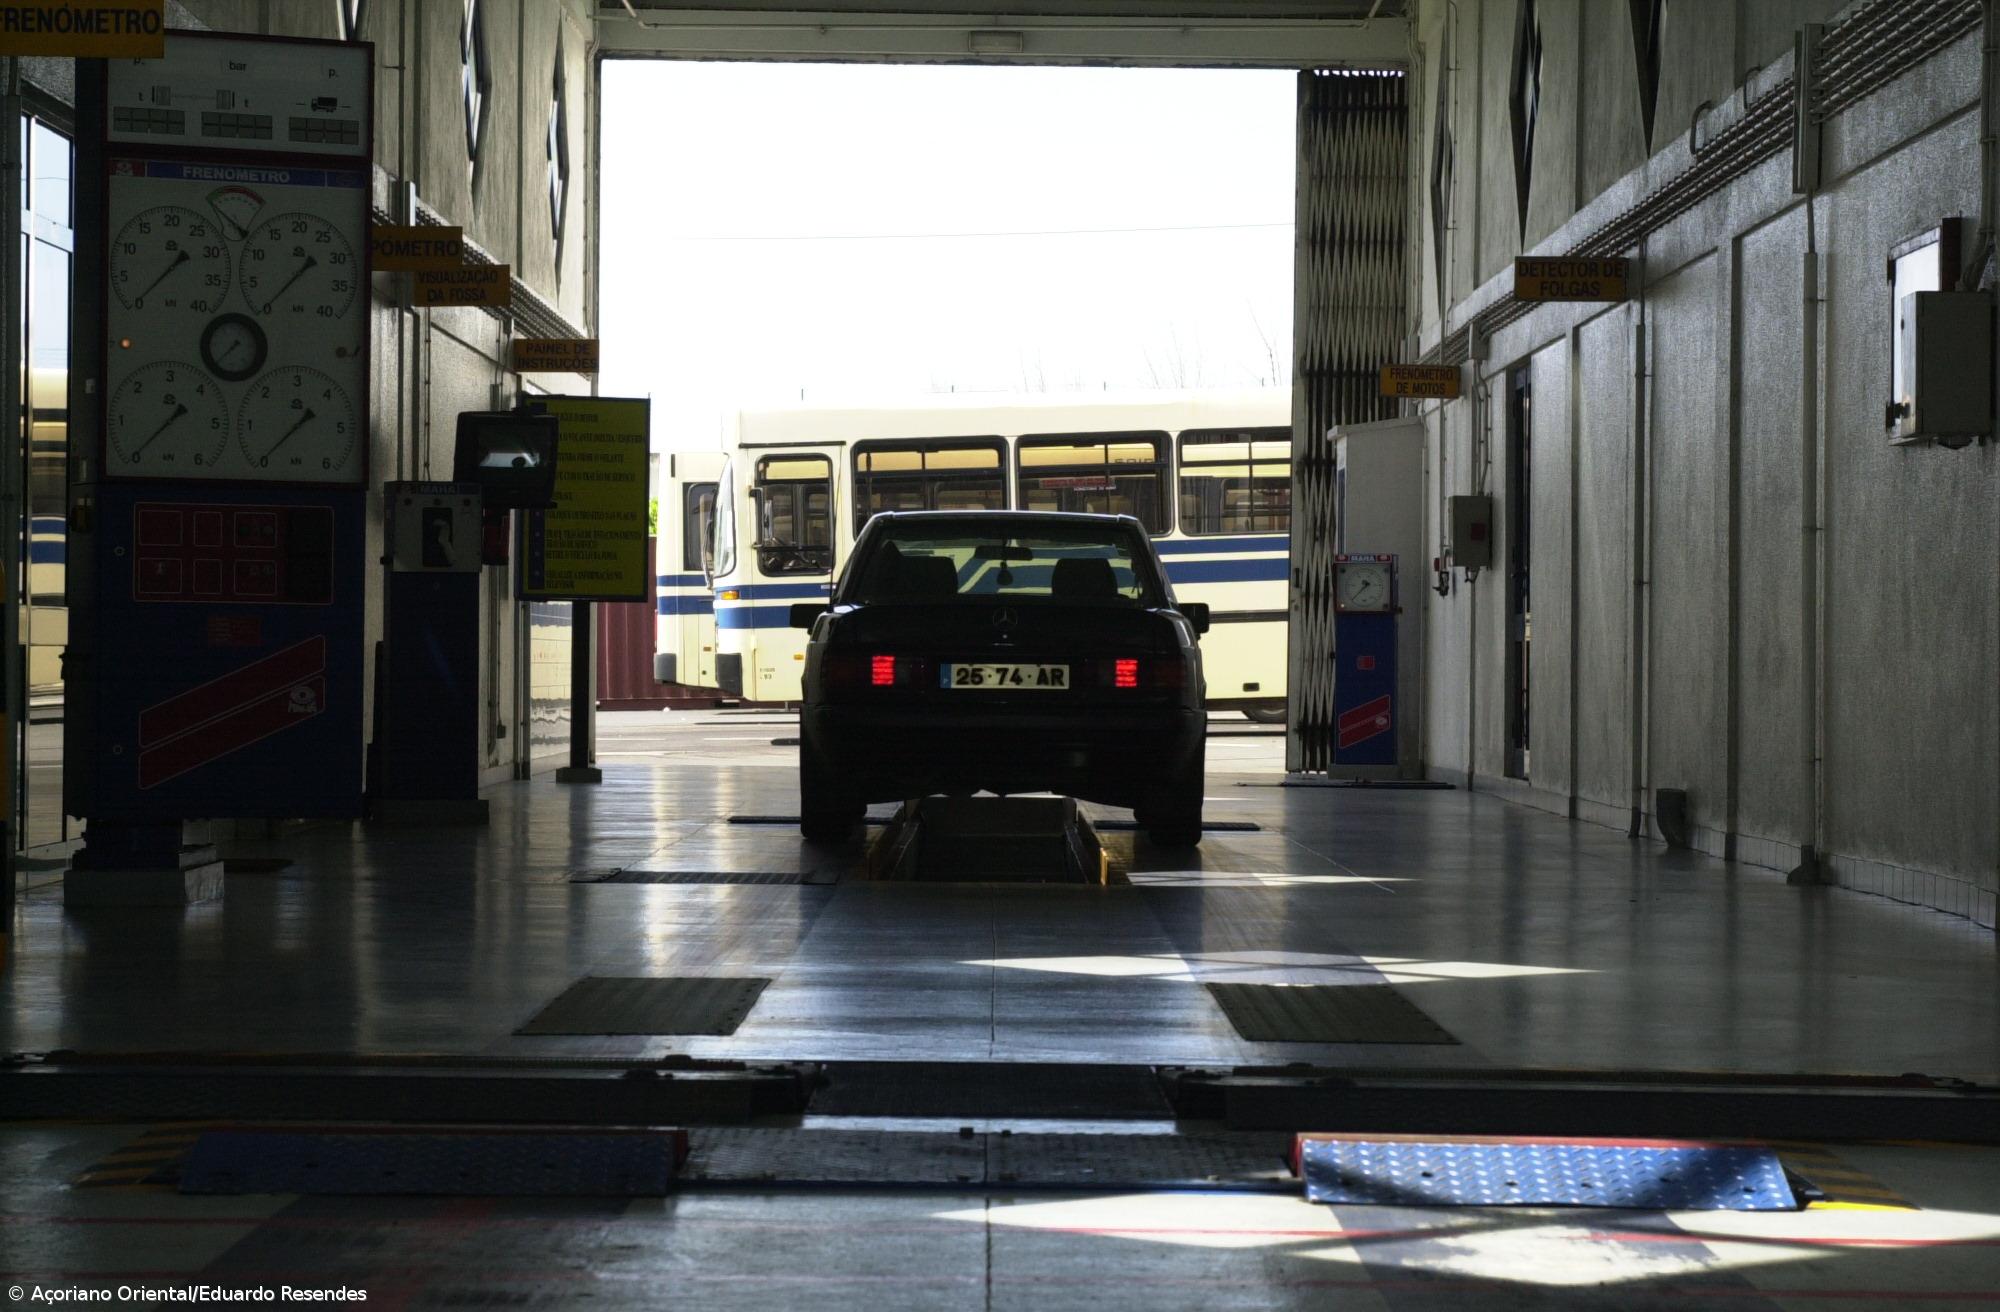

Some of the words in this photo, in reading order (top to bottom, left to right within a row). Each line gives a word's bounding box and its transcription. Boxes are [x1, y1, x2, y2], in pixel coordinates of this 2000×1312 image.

[0, 2, 160, 34] RENÓMETRO
[229, 61, 246, 71] bar
[182, 165, 290, 183] FRENOMETRO
[164, 215, 180, 227] 20
[139, 223, 151, 234] 15
[189, 225, 205, 237] 25
[292, 222, 307, 233] 20
[269, 229, 281, 241] 15
[315, 231, 332, 244] 25
[124, 243, 136, 255] 10
[203, 247, 220, 258] 30
[252, 249, 265, 261] 10
[330, 252, 346, 264] 30
[1518, 261, 1598, 277] DETECTOR
[1603, 261, 1624, 277] DE
[120, 270, 128, 282] 5
[205, 275, 221, 286] 35
[250, 277, 258, 288] 5
[332, 280, 348, 292] 35
[427, 288, 443, 302] DA
[449, 288, 487, 301] FOSSA
[1540, 281, 1600, 297] FOLGAS
[135, 298, 144, 309] 0
[190, 301, 207, 313] 40
[263, 303, 271, 314] 0
[317, 305, 334, 317] 40
[574, 342, 590, 354] DE
[166, 370, 174, 382] 3
[293, 375, 301, 387] 3
[134, 381, 143, 394] 2
[196, 384, 204, 395] 4
[262, 387, 270, 398] 2
[1396, 381, 1409, 394] DE
[1412, 382, 1446, 395] MOTOS
[323, 389, 332, 400] 4
[211, 418, 220, 430] 5
[337, 423, 345, 434] 5
[131, 452, 140, 464] 0
[194, 453, 203, 465] 6
[260, 456, 269, 468] 0
[322, 458, 330, 470] 6
